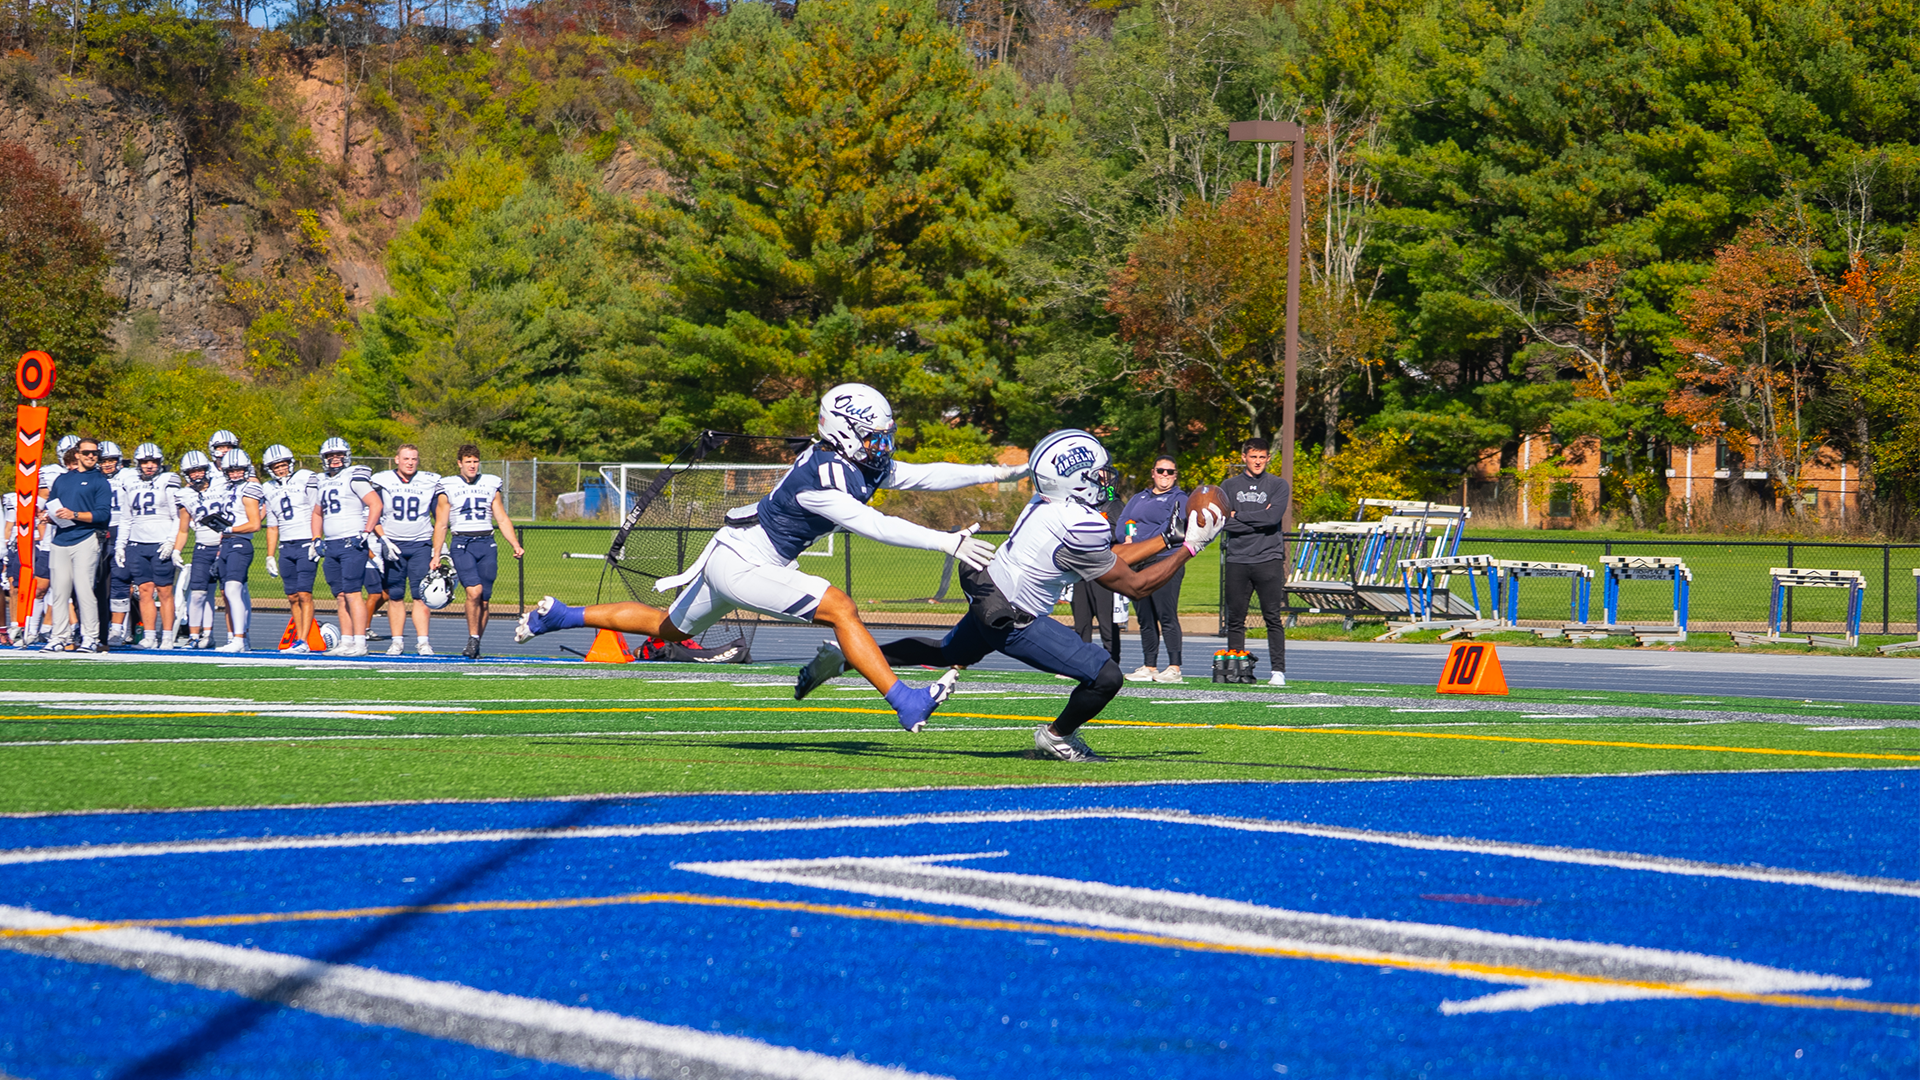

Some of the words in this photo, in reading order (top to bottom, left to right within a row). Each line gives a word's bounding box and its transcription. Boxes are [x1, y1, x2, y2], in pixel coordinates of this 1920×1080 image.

[834, 394, 878, 422] Owls
[1057, 450, 1095, 475] ANSELM
[132, 492, 156, 516] 42
[281, 496, 294, 520] 8
[321, 489, 342, 515] 46
[392, 495, 420, 521] 98
[460, 497, 487, 520] 45
[1448, 646, 1484, 685] 10
